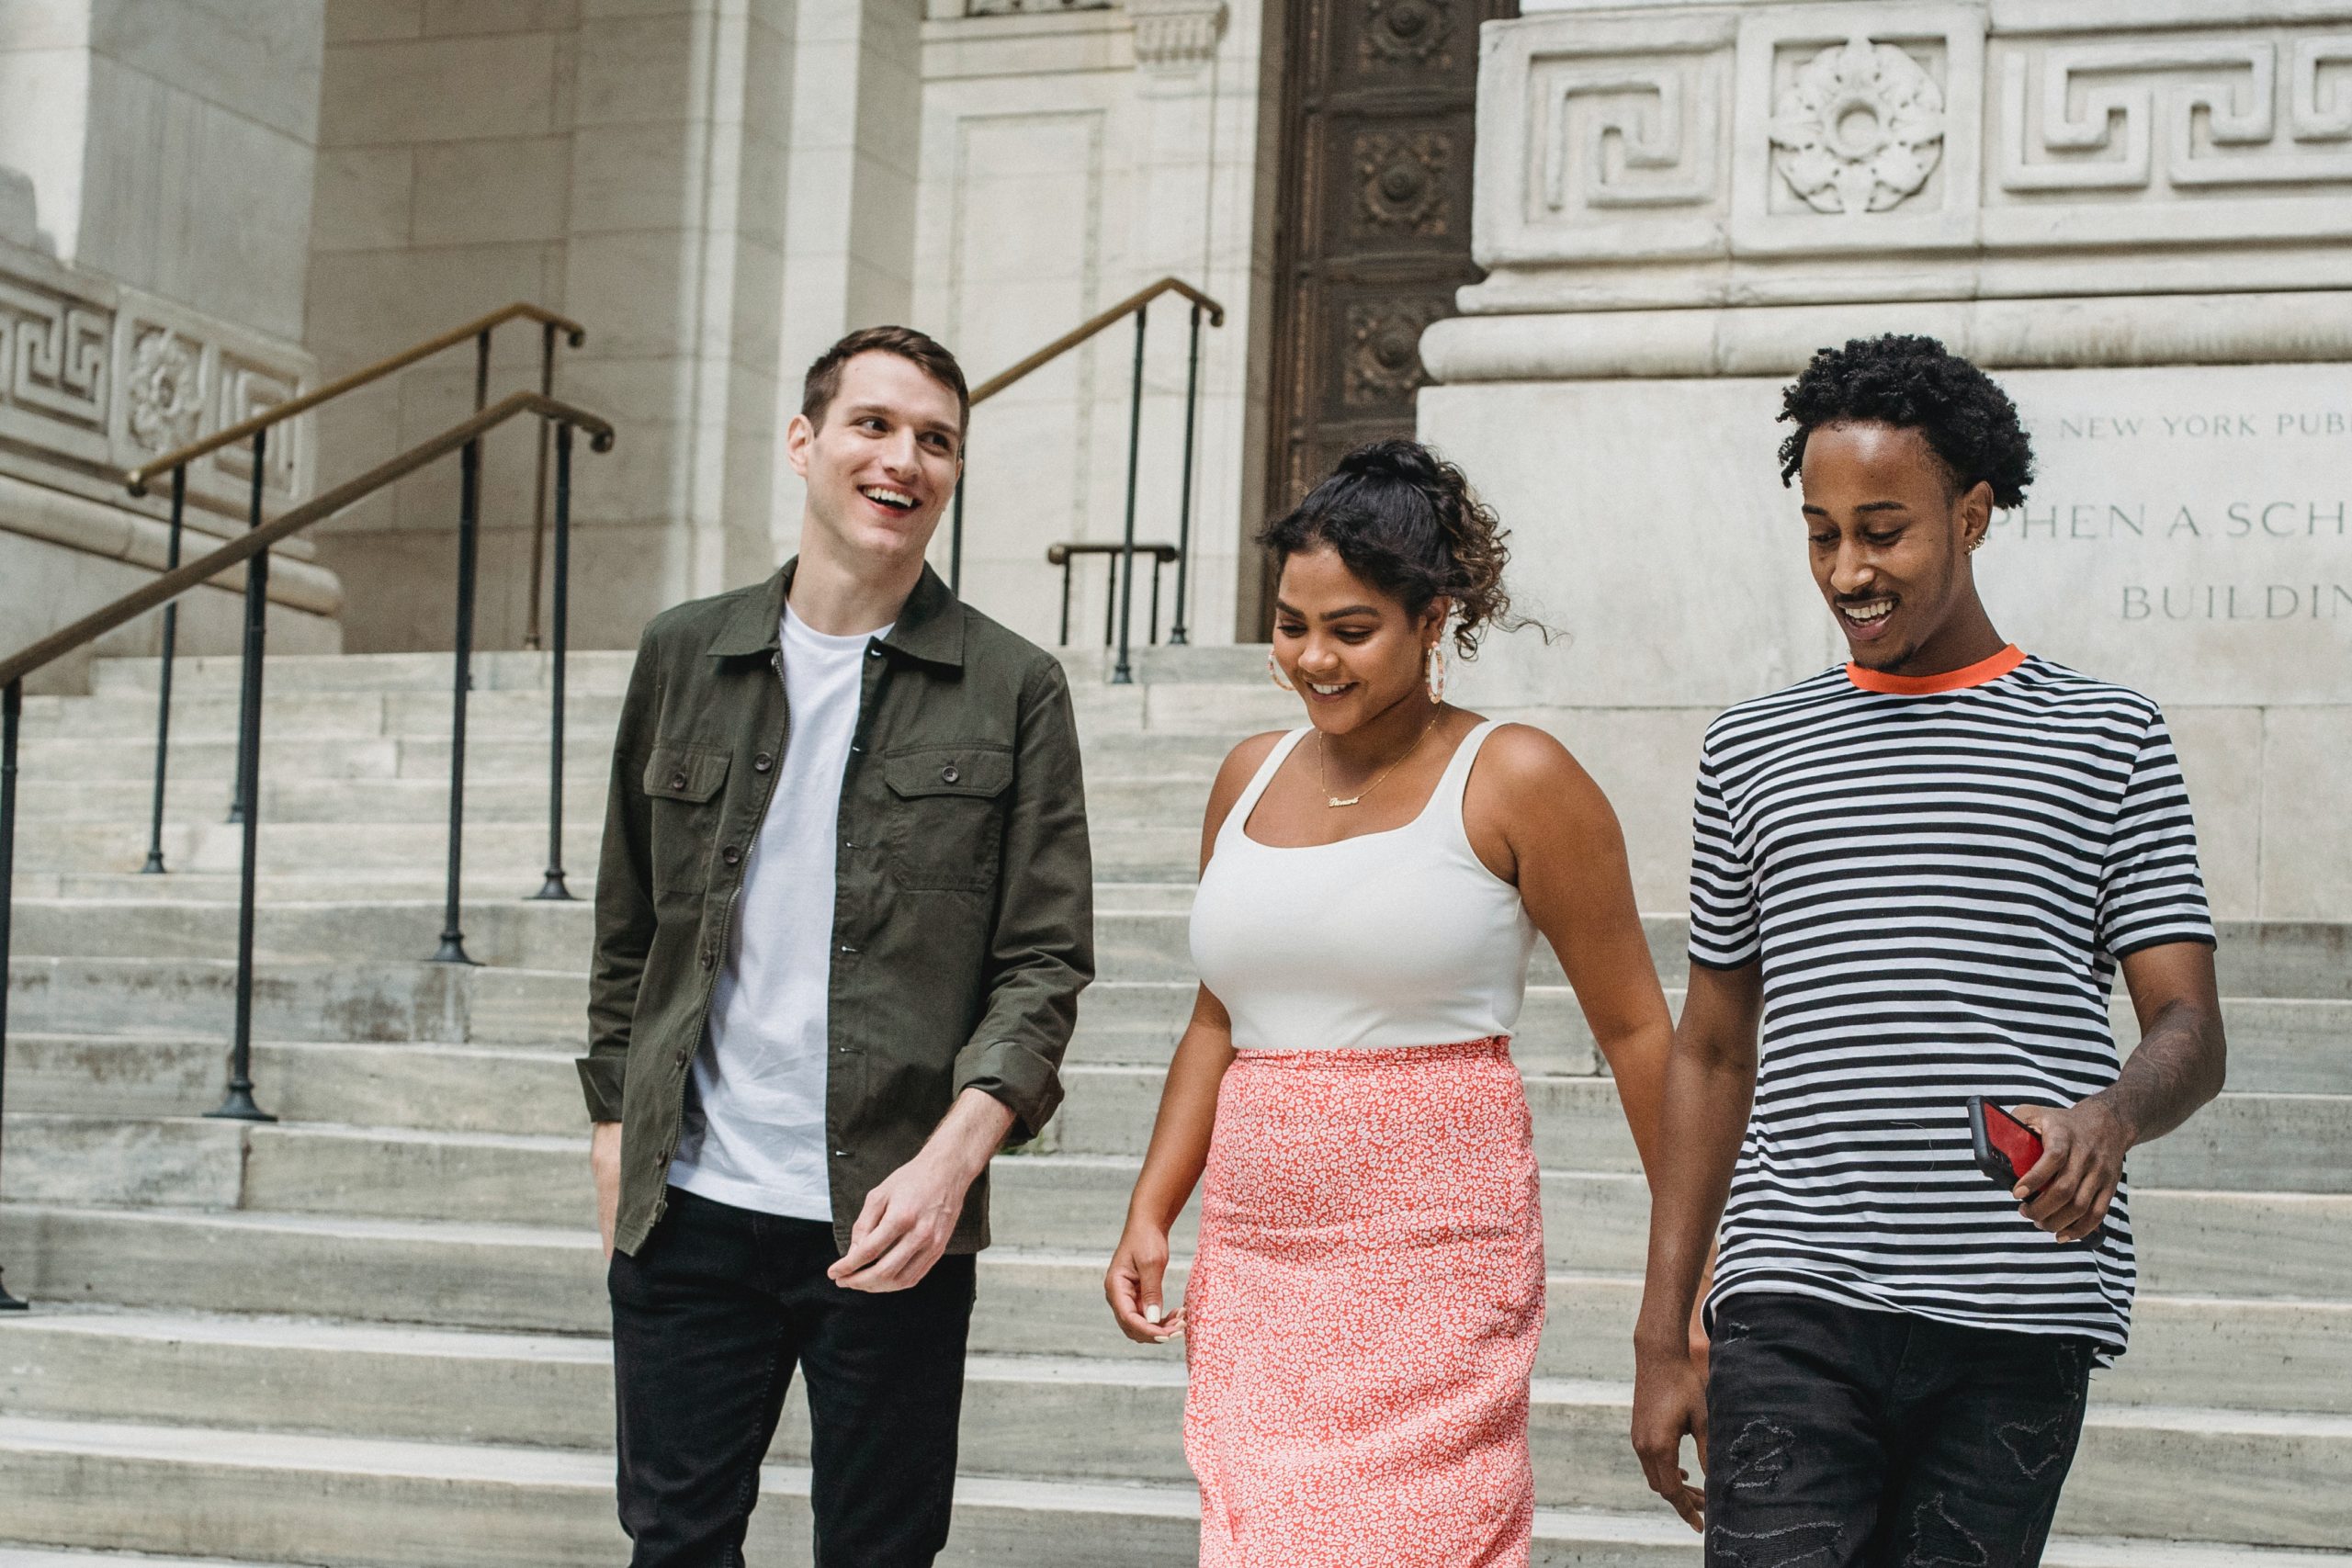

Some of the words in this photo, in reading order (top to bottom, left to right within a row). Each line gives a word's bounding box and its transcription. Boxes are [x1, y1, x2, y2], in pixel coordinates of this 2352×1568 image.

[2061, 417, 2143, 439] NEW
[2162, 413, 2256, 436] YORK
[2277, 411, 2352, 436] PUB
[2226, 501, 2346, 539] SCH
